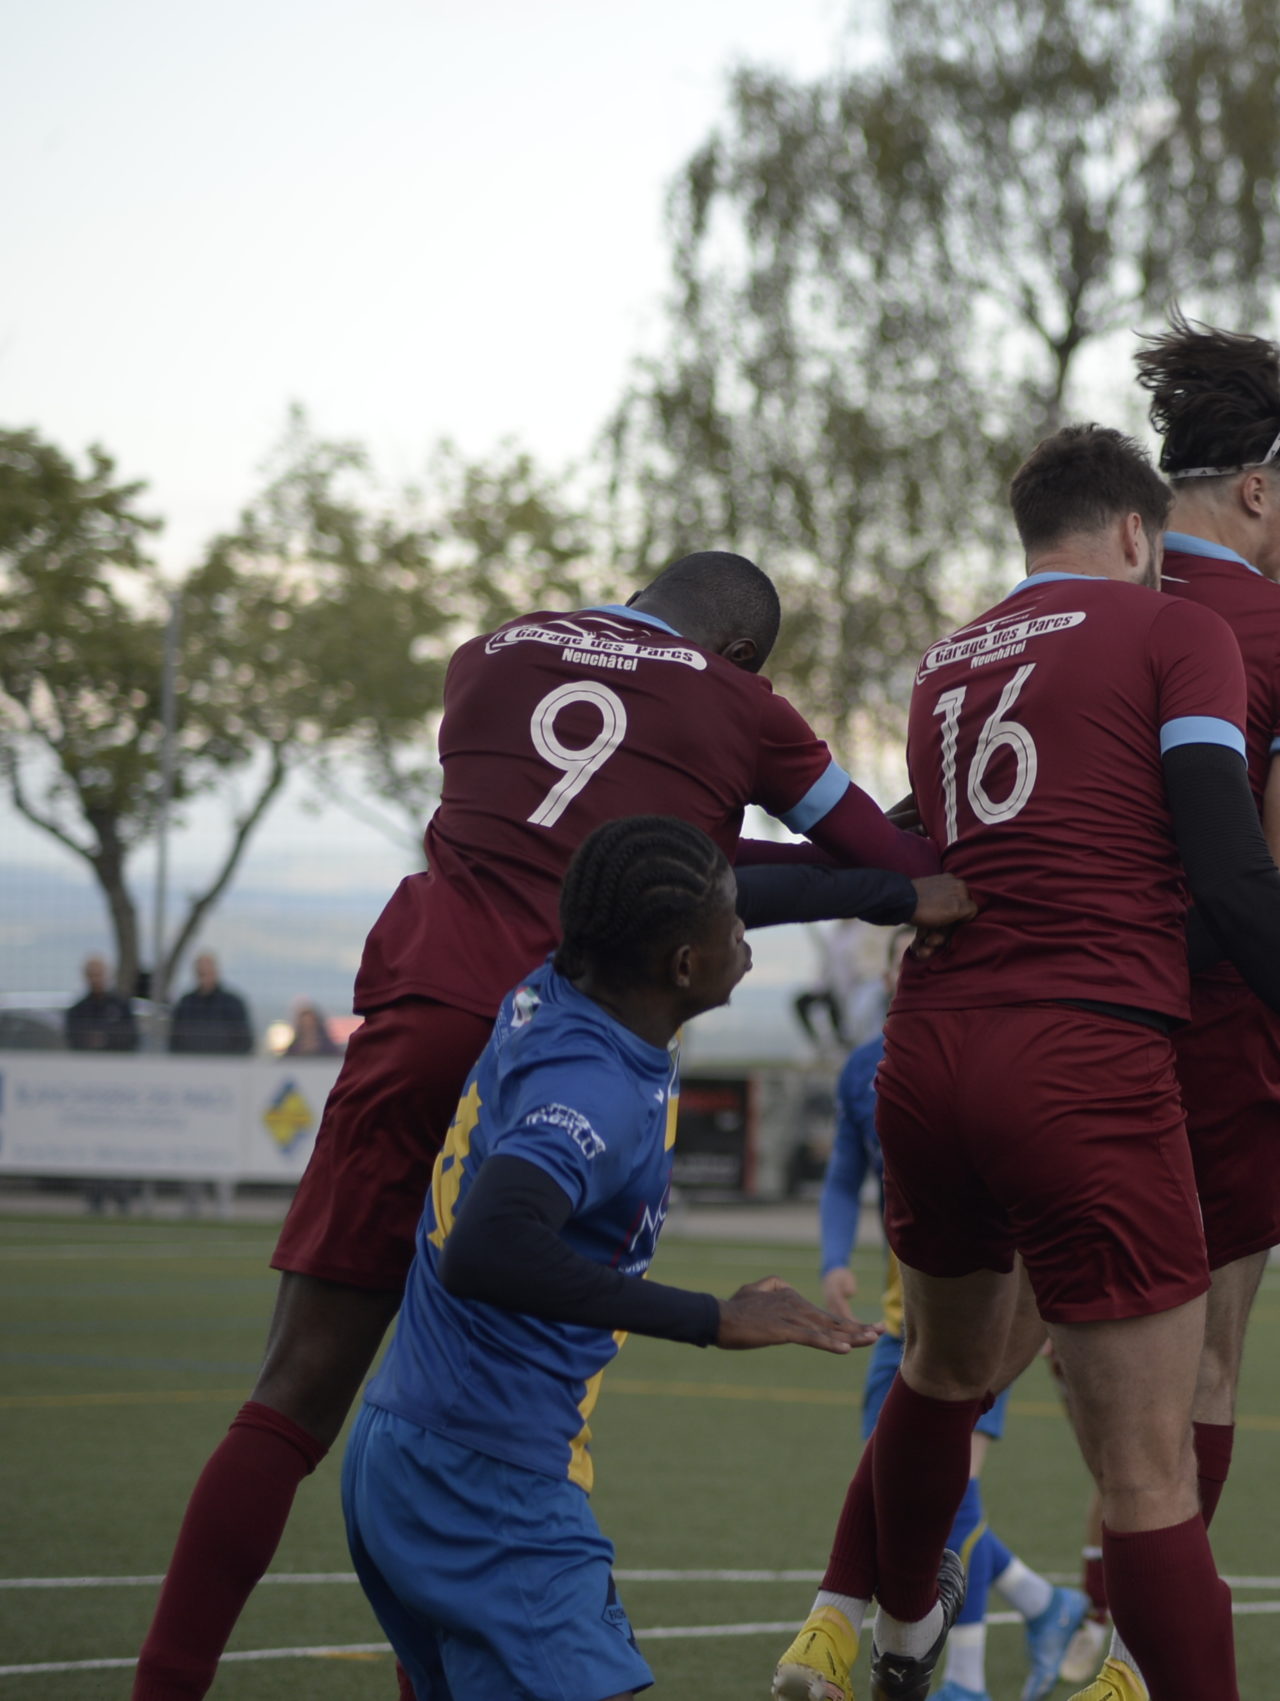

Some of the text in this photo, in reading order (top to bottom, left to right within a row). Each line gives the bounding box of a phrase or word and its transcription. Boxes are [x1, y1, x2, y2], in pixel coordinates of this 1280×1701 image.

[515, 627, 693, 662] Garage des Parcs
[562, 647, 638, 671] Neuchâtel
[935, 614, 1073, 663] Garage des Parcs
[970, 640, 1026, 669] Neuchâtel
[526, 680, 627, 828] 9
[932, 662, 1037, 846] 16
